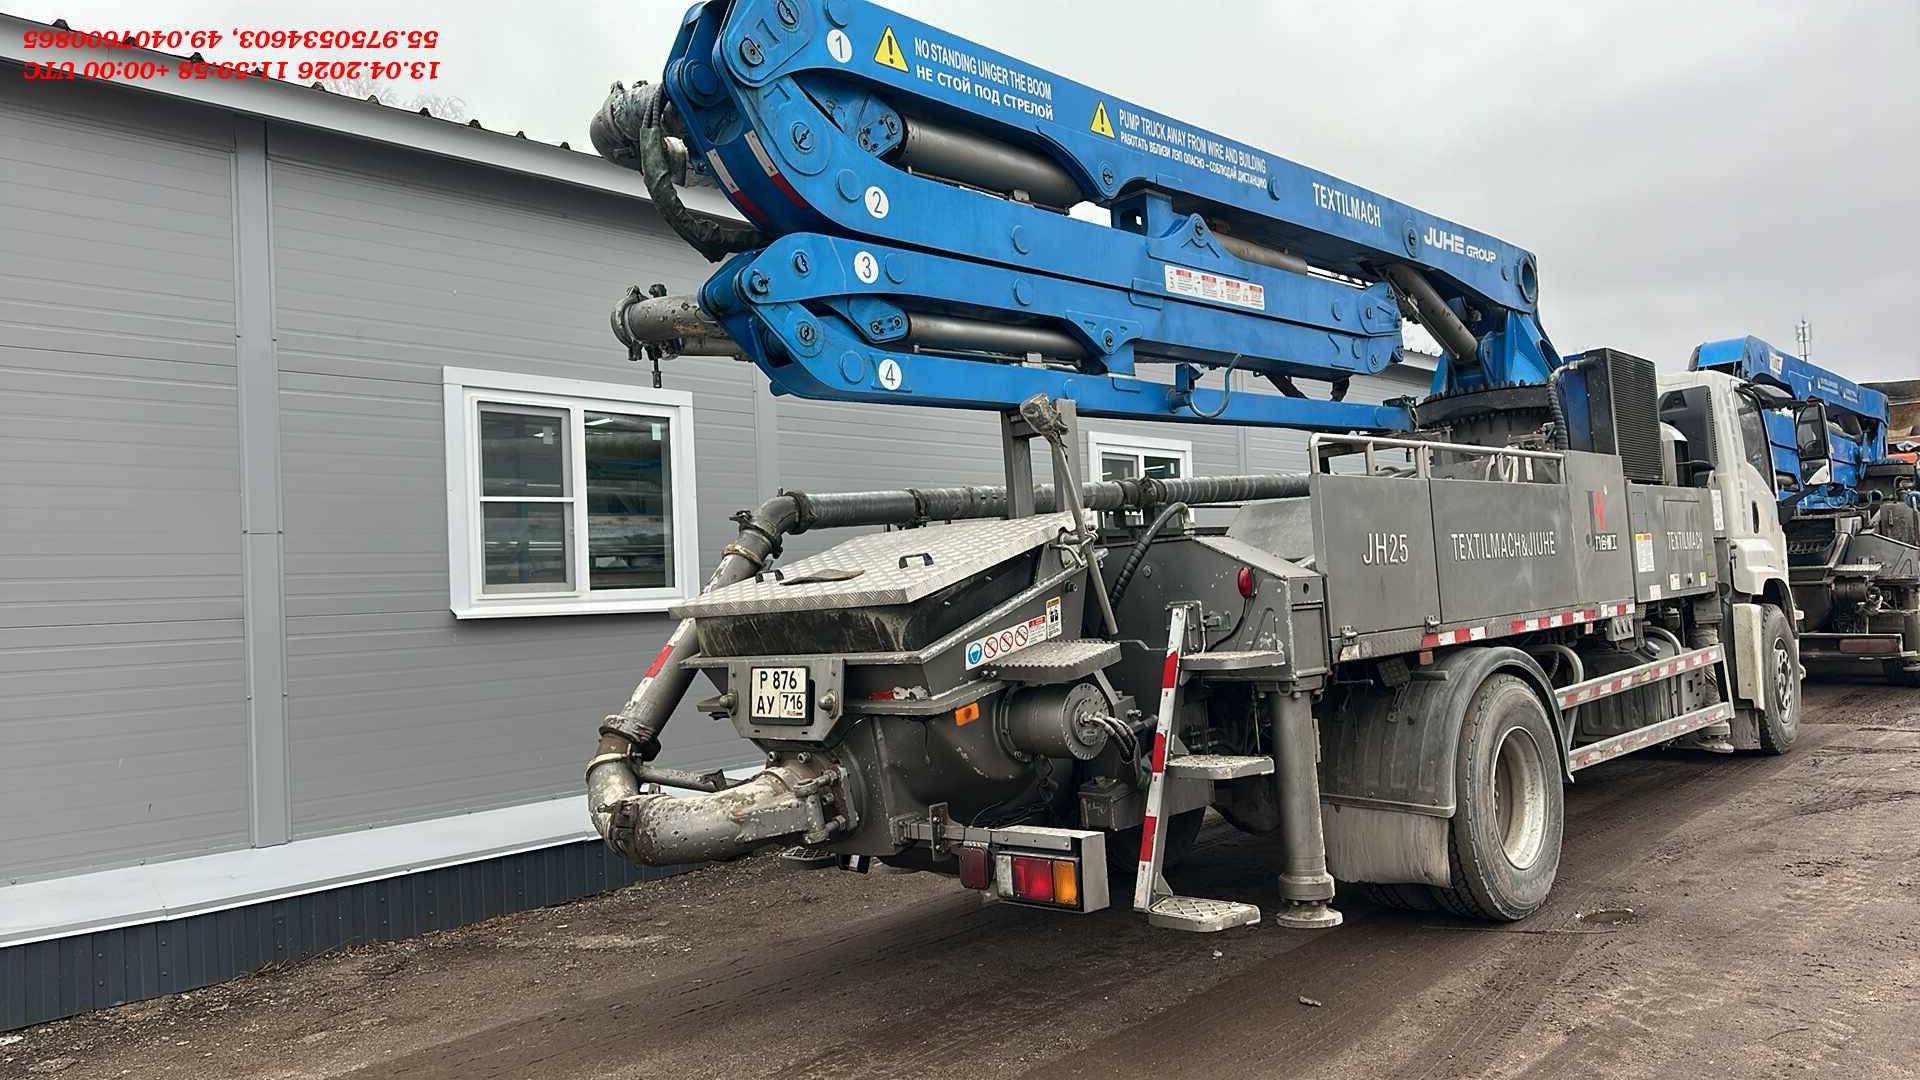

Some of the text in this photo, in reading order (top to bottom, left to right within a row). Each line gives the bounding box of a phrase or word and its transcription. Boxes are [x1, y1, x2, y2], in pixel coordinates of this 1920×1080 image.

[835, 35, 843, 59] 1
[914, 36, 1052, 100] NO STANDING UNGER THE BOOM
[916, 64, 1054, 121] НЕ СТОЙ ПОД СТРЕЛОЙ
[1119, 108, 1266, 174] PUMP TRUCK AWAY FROM WIRE AND BUILDING
[1120, 132, 1148, 151] РАБОТАТЬ
[872, 191, 883, 214] 2
[1312, 182, 1382, 228] TEXTILMACH
[1424, 226, 1496, 263] JUHE GROUP
[862, 256, 872, 278] 3
[886, 364, 896, 386] 4
[1362, 532, 1409, 565] JH25
[1450, 531, 1556, 562] TEXTILMACH&JIUHE
[772, 670, 798, 690] 876
[782, 694, 803, 710] 716
